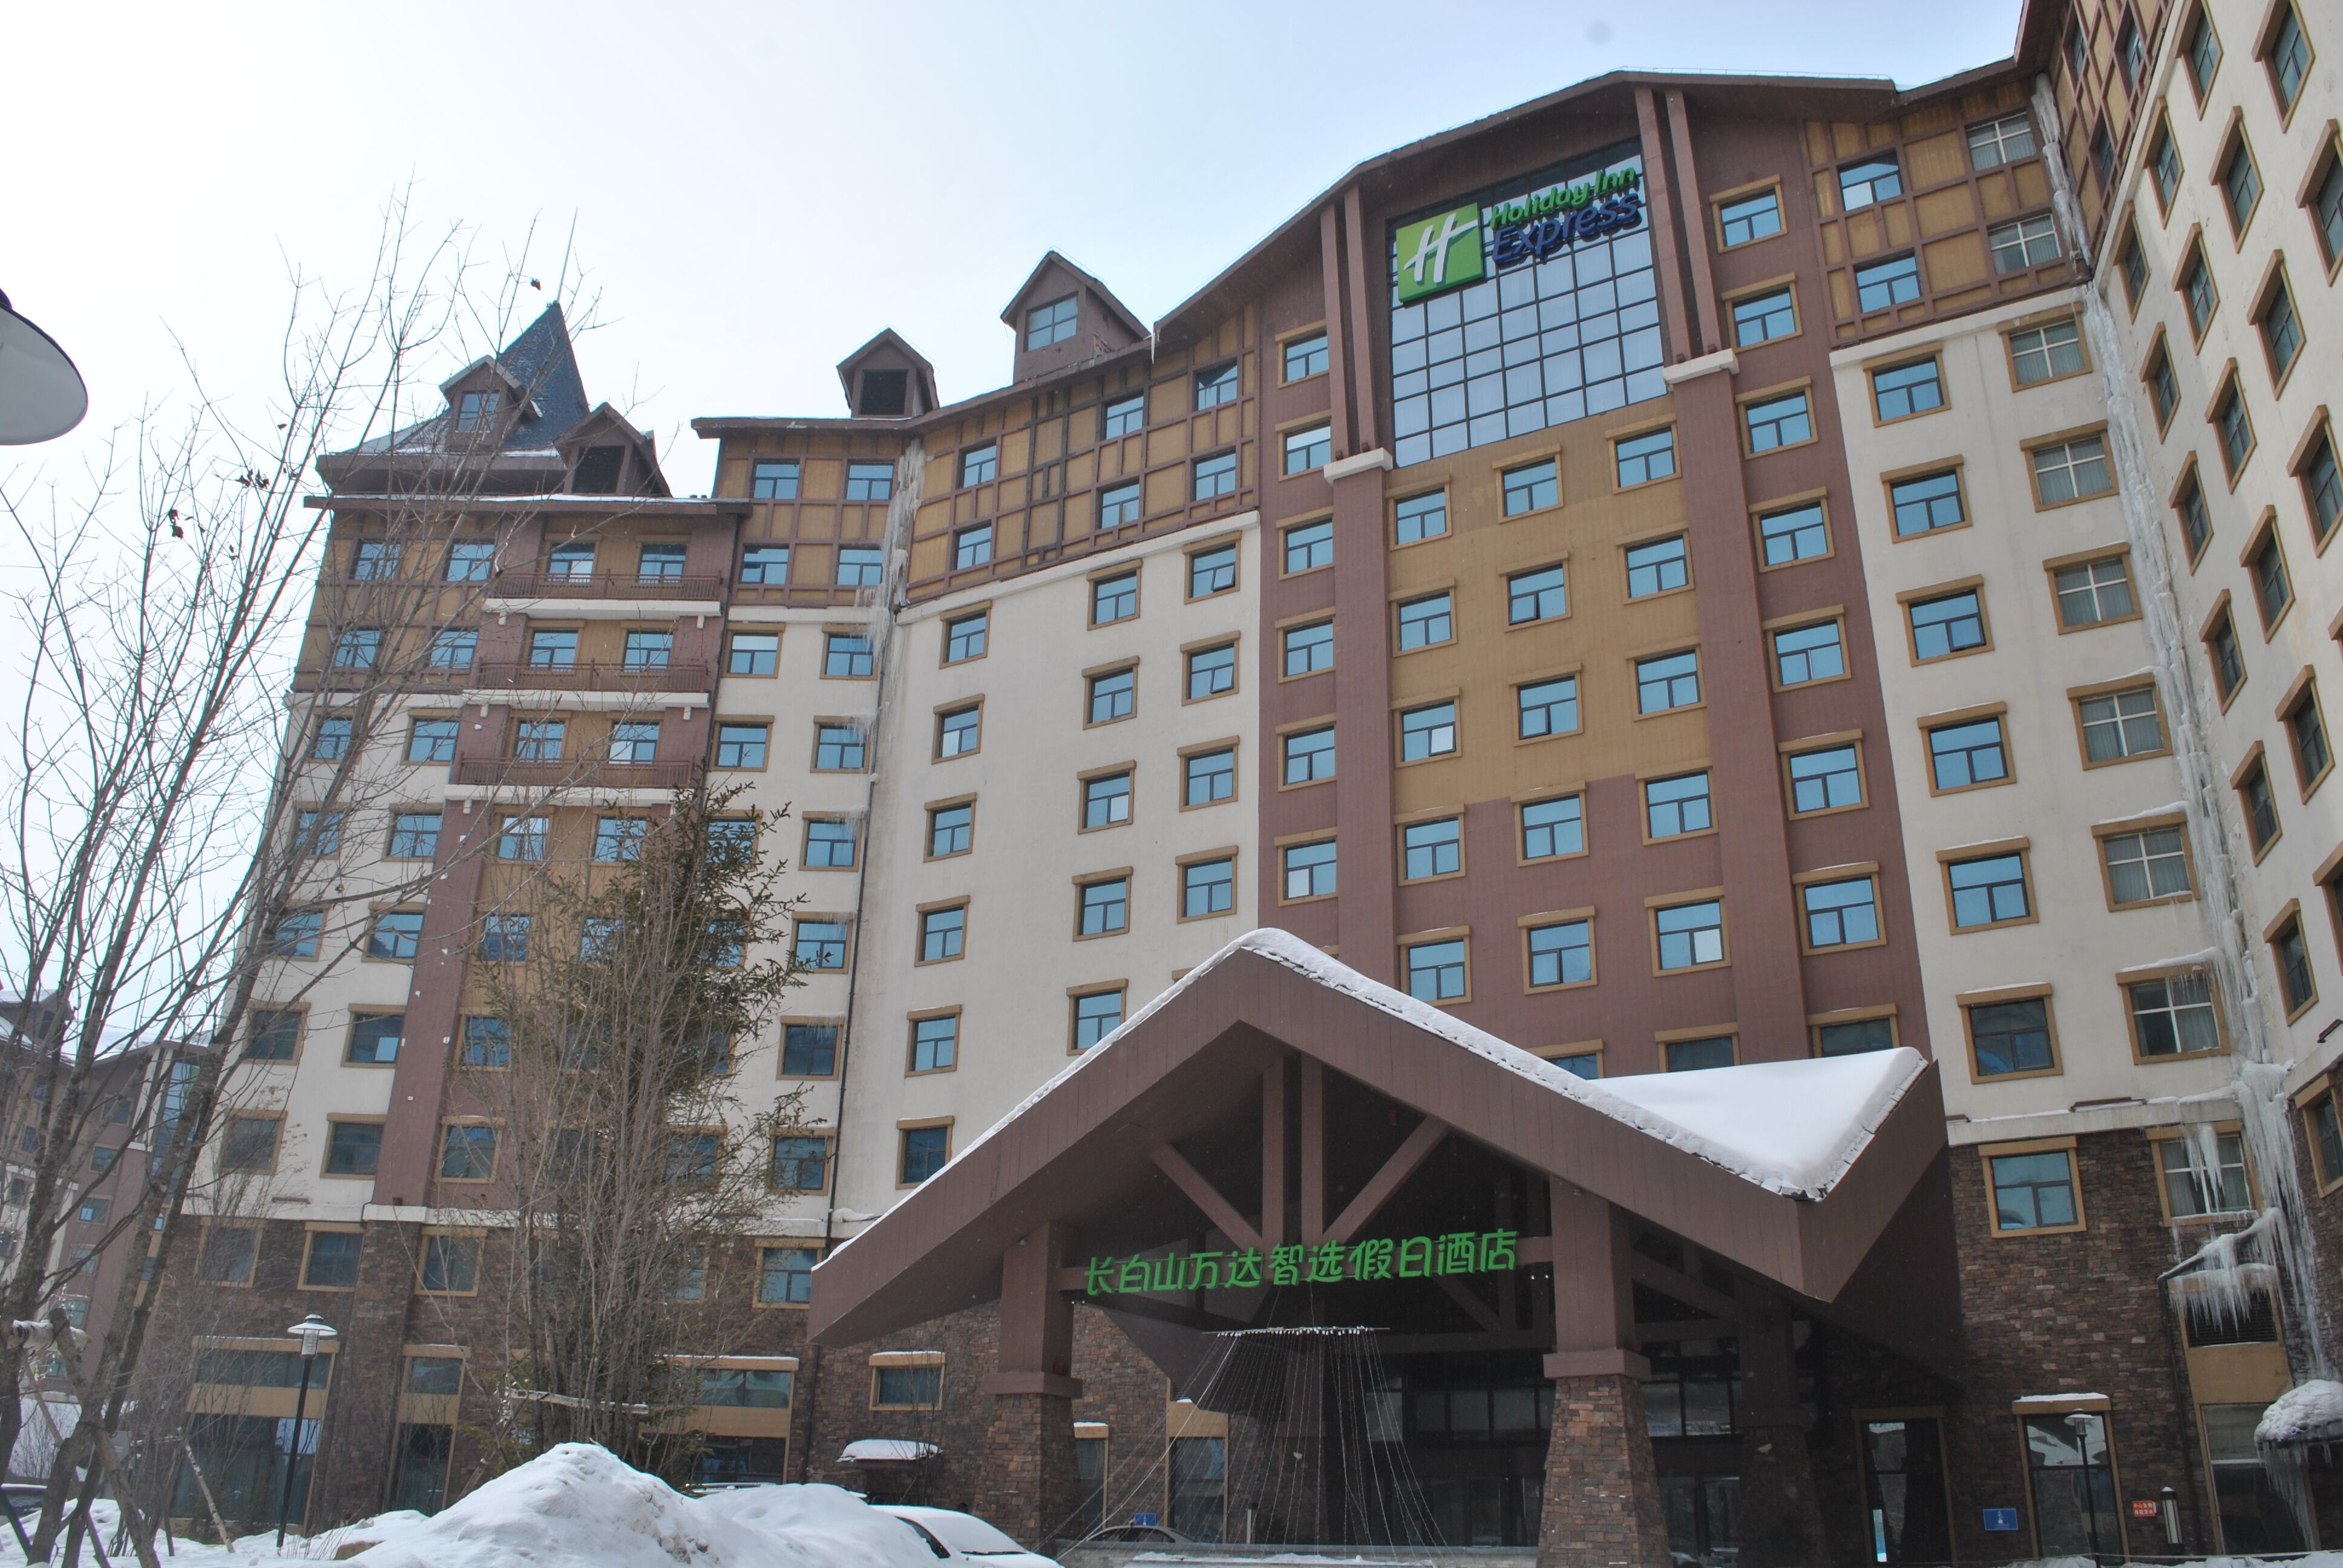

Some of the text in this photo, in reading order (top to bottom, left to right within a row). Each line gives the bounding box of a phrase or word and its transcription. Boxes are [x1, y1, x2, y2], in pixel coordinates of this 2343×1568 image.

[1489, 167, 1636, 230] Holiday Inn
[1492, 193, 1639, 263] Express
[1084, 1228, 1518, 1296] 长白山万达智选假日酒店
